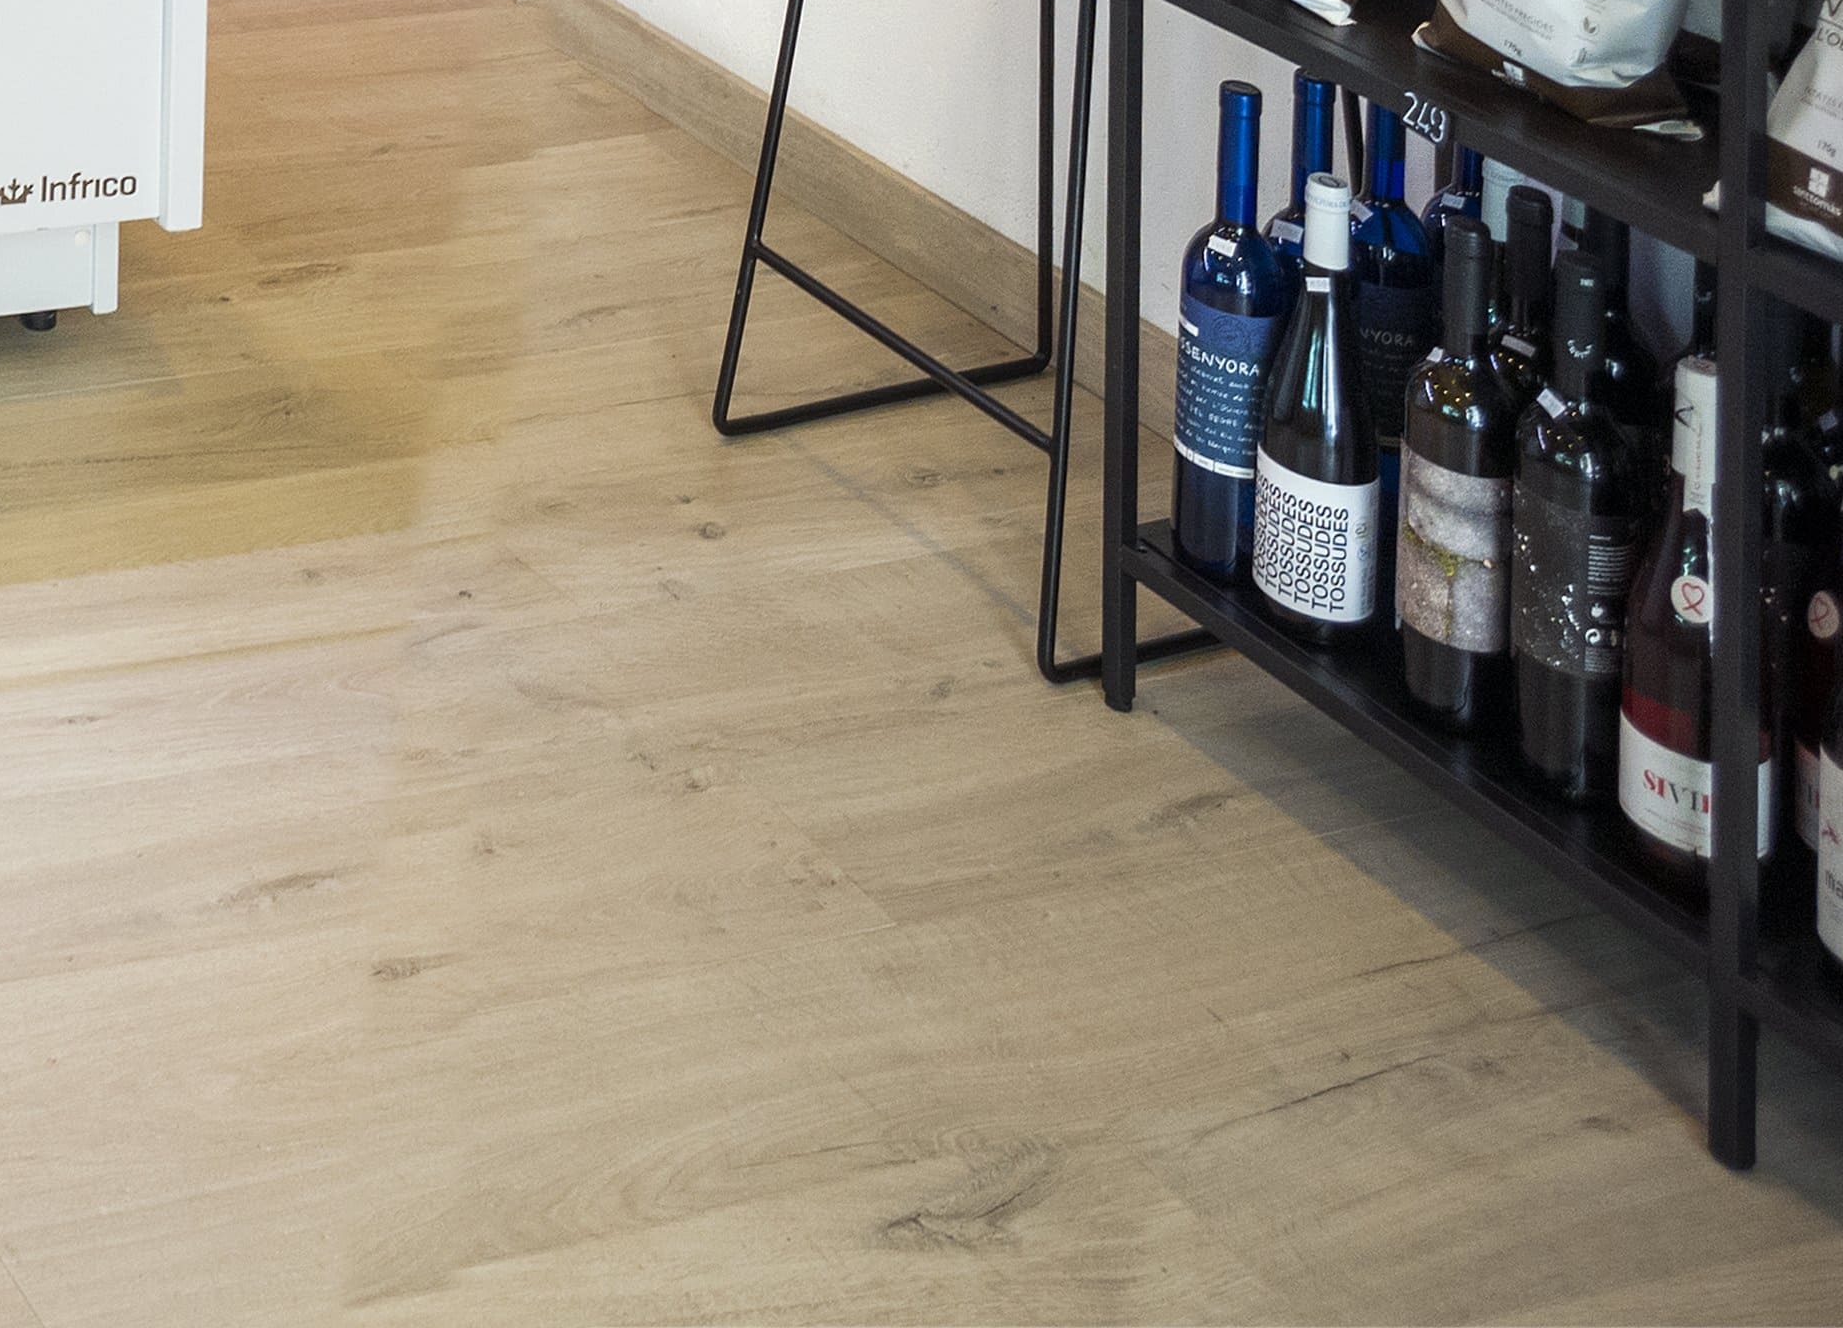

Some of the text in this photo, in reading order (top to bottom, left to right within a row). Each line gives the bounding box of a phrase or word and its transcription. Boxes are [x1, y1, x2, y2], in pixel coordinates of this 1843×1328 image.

[41, 172, 137, 202] Infrico
[1265, 483, 1282, 588] TOSSUDES
[1278, 491, 1297, 597] TOSSUDES
[1293, 499, 1314, 604] TOSSUDES
[1311, 504, 1332, 610] TOSSUDES
[1329, 508, 1349, 614] TOSSUDES
